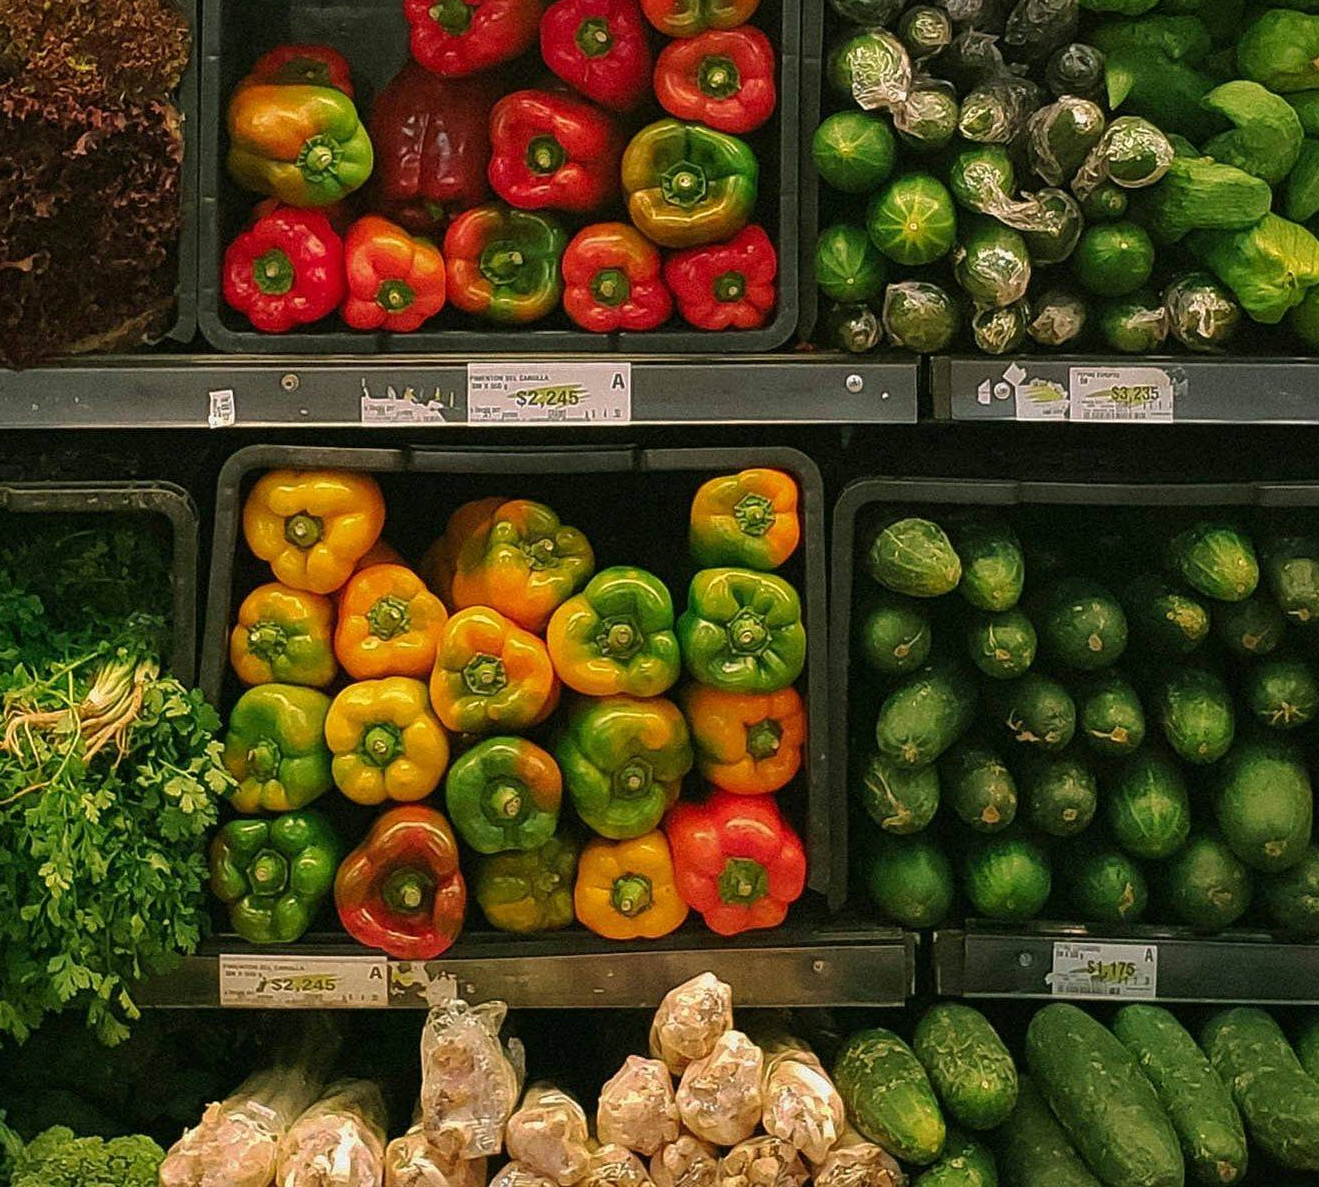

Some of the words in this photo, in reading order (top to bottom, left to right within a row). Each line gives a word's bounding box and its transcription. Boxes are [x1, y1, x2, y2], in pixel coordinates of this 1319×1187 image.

[612, 373, 625, 389] A
[516, 389, 579, 408] $2,245
[1111, 385, 1159, 401] $3,235
[1144, 947, 1153, 962] A
[369, 965, 383, 980] A
[1087, 960, 1136, 978] $1,175
[271, 978, 336, 992] $2,245
